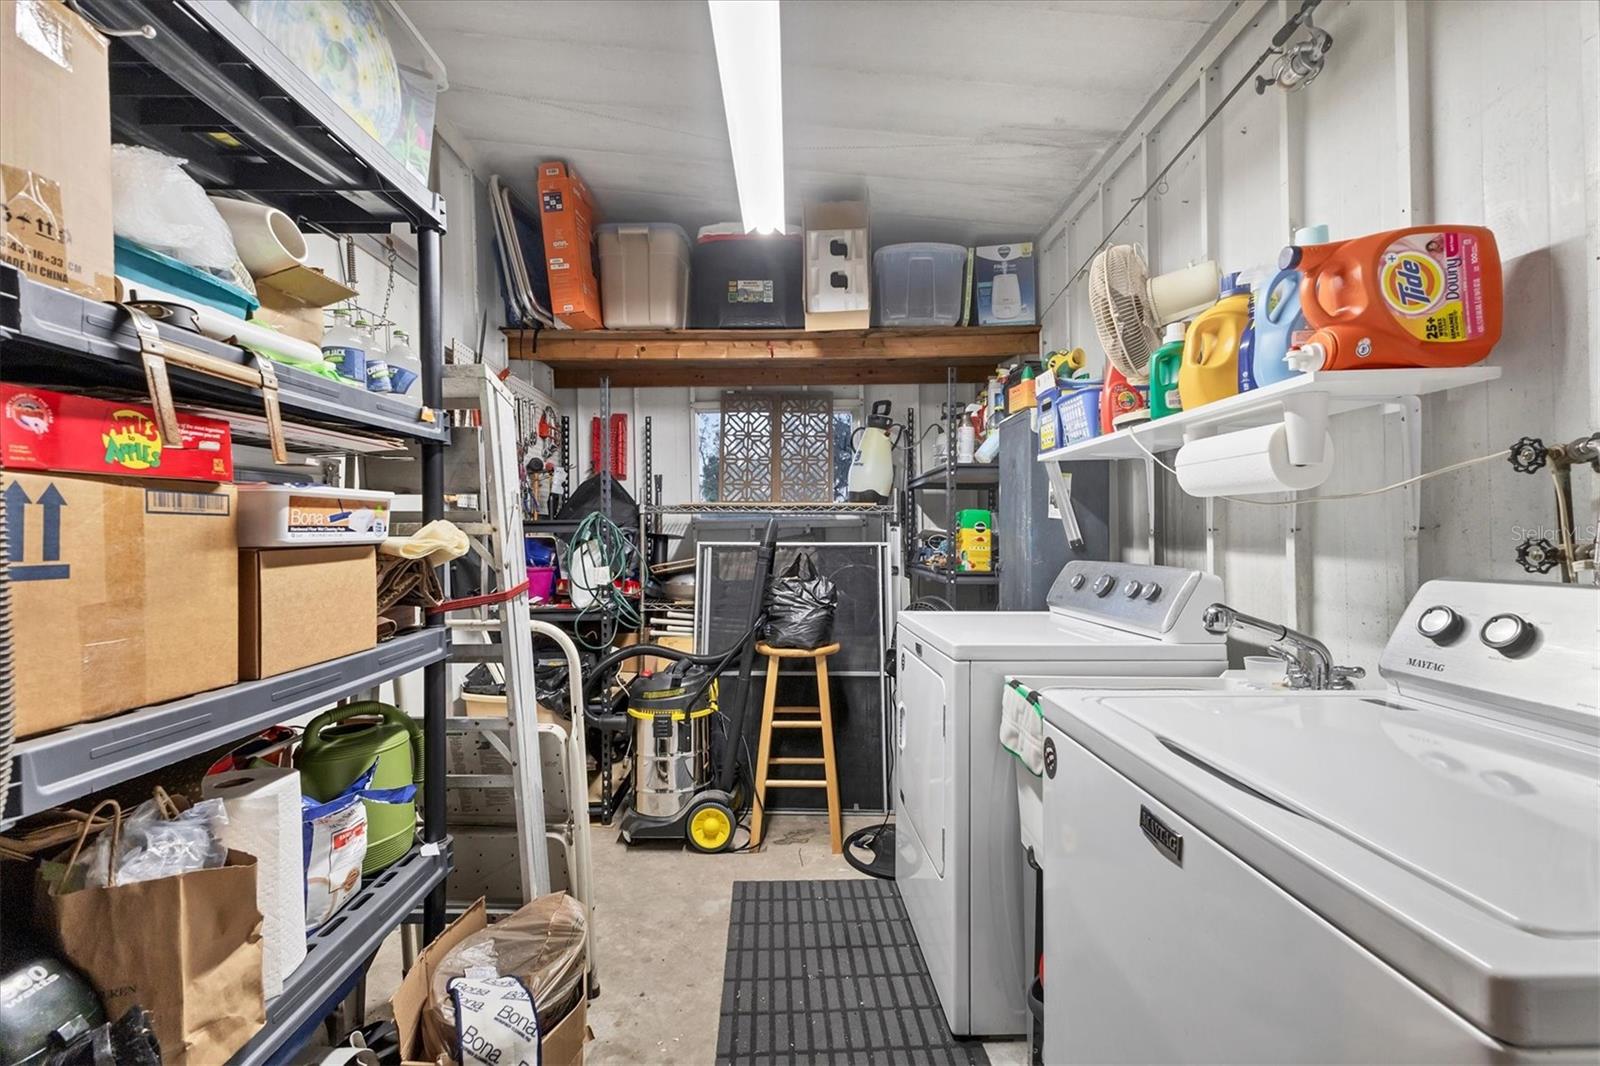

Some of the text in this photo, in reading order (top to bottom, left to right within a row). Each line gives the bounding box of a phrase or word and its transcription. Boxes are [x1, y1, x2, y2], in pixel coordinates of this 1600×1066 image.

[40, 266, 69, 284] CHINA
[1397, 259, 1431, 306] Tide
[1445, 256, 1462, 300] Downy
[1426, 317, 1438, 339] 25+
[105, 436, 161, 468] APPLES
[290, 508, 324, 526] Bona
[1406, 657, 1446, 673] MAYTAG
[1142, 810, 1178, 852] MAYTAG
[497, 1004, 537, 1038] Bona
[462, 1025, 503, 1065] Bona
